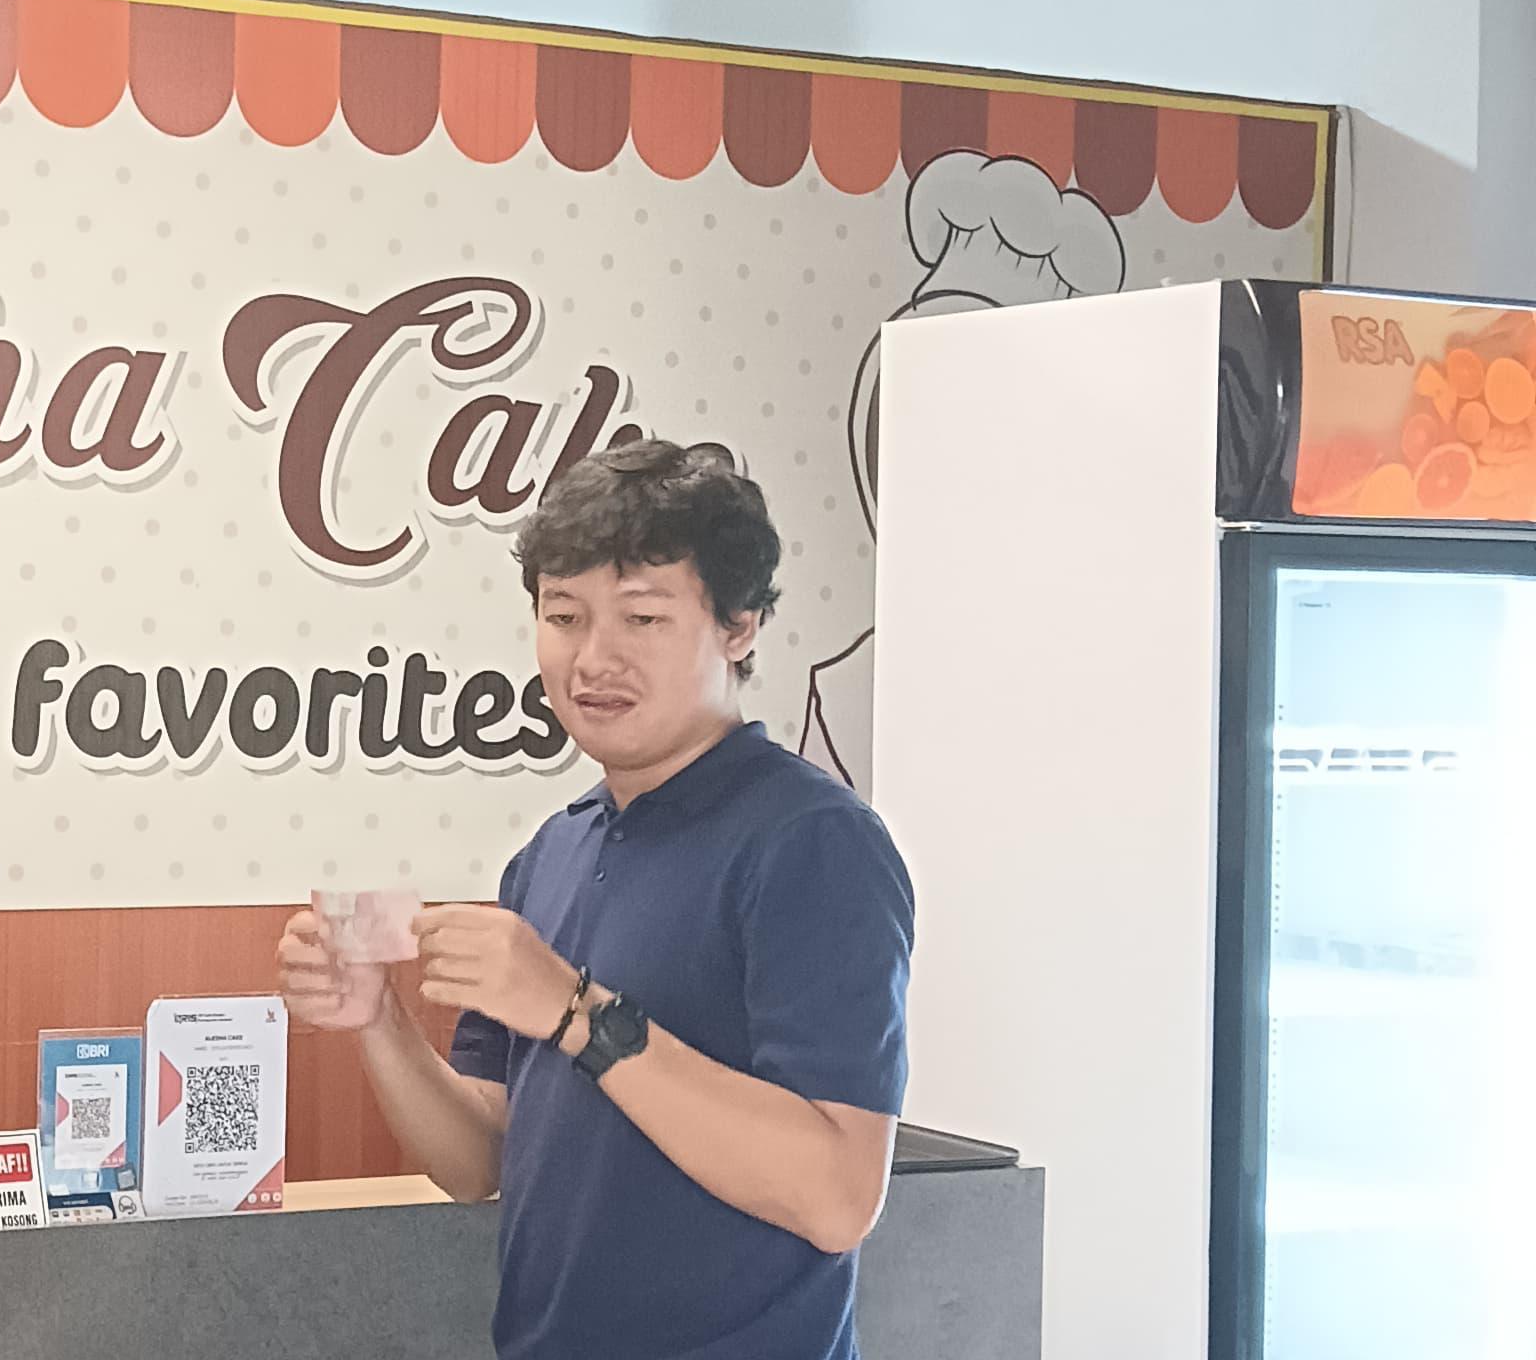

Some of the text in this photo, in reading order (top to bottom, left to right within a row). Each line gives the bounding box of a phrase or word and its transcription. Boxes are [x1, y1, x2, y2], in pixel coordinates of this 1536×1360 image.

[1331, 315, 1414, 366] RSA
[12, 639, 569, 760] favorites
[89, 1043, 110, 1058] BRI
[1, 1213, 38, 1228] KOSONG
